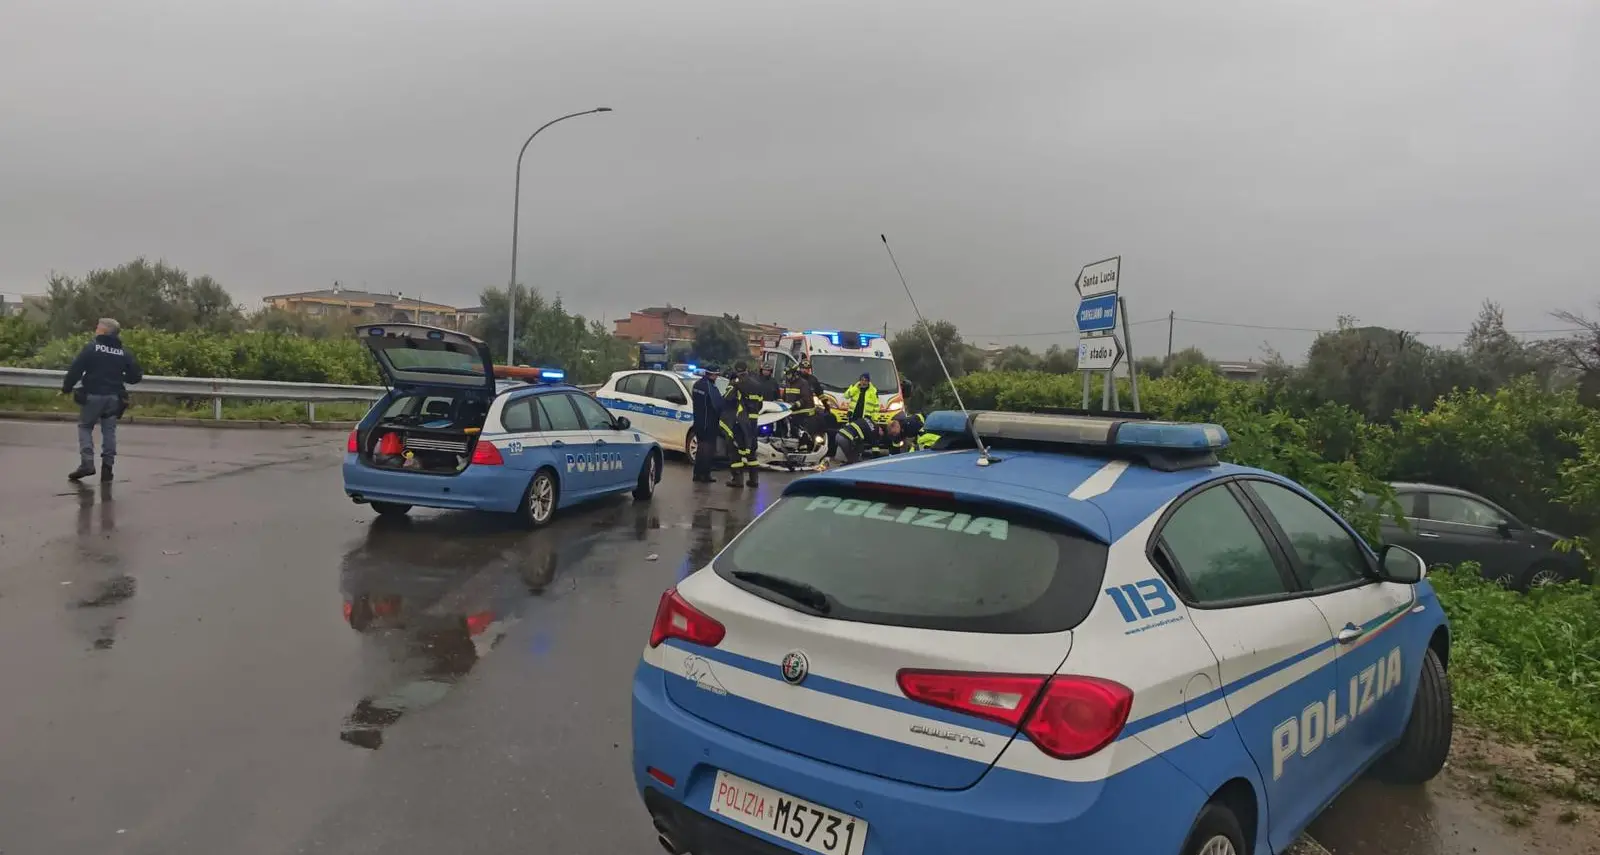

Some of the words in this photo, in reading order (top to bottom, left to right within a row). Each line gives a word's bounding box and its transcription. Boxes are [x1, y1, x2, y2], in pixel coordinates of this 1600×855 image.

[1083, 273, 1099, 287] Santa
[1100, 270, 1115, 283] Lucia
[95, 344, 124, 356] POLIZIA
[1090, 346, 1108, 359] stadio
[507, 440, 523, 453] 113
[565, 452, 624, 473] POLIZIA
[804, 495, 1009, 540] POLIZIA
[1105, 578, 1176, 623] 113
[1272, 645, 1401, 782] POLIZIA
[910, 724, 986, 747] GIULIETTA
[717, 782, 765, 820] POLIZIA
[773, 797, 855, 855] M5731
